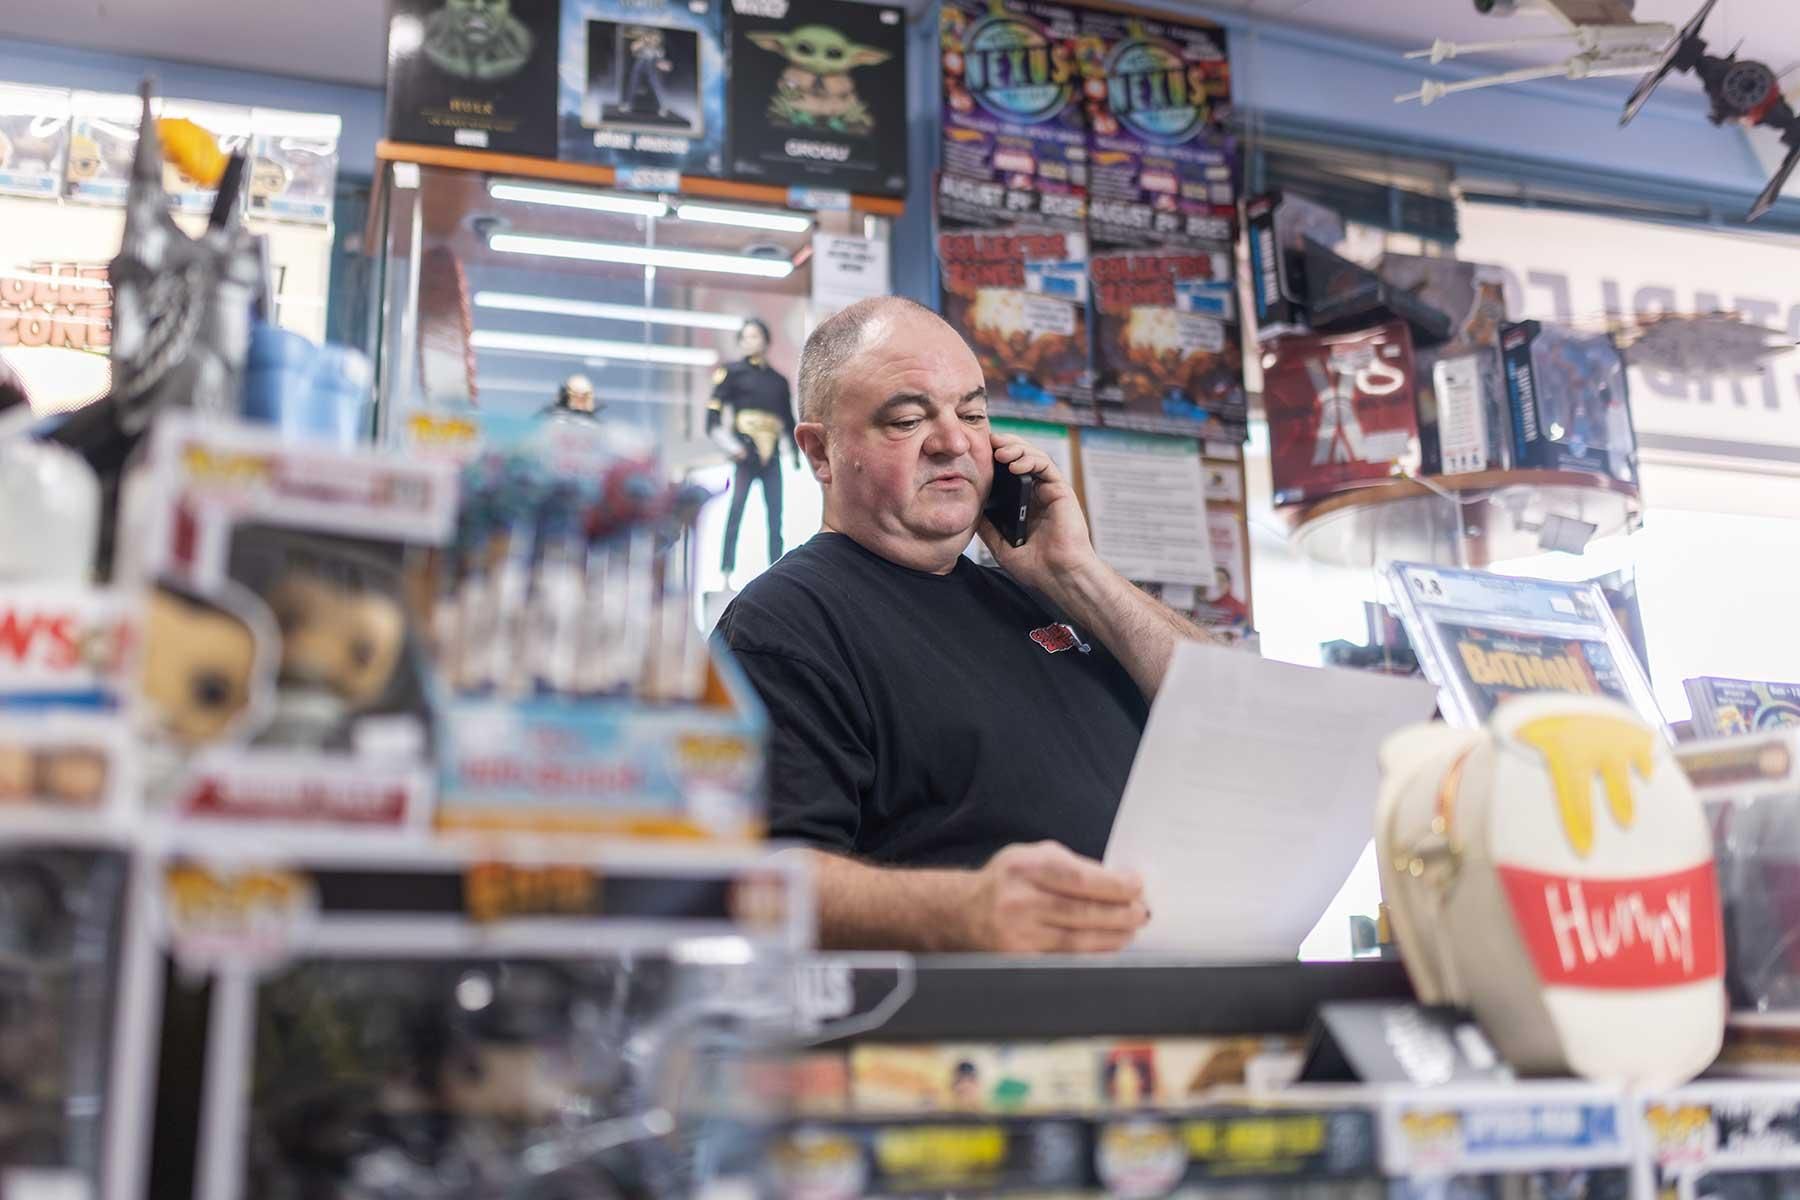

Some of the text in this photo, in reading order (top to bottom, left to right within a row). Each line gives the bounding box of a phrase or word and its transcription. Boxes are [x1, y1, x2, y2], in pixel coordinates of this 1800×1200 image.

[784, 138, 851, 162] GROGU
[1457, 639, 1592, 695] BATMAN
[1545, 882, 1693, 974] Hunny
